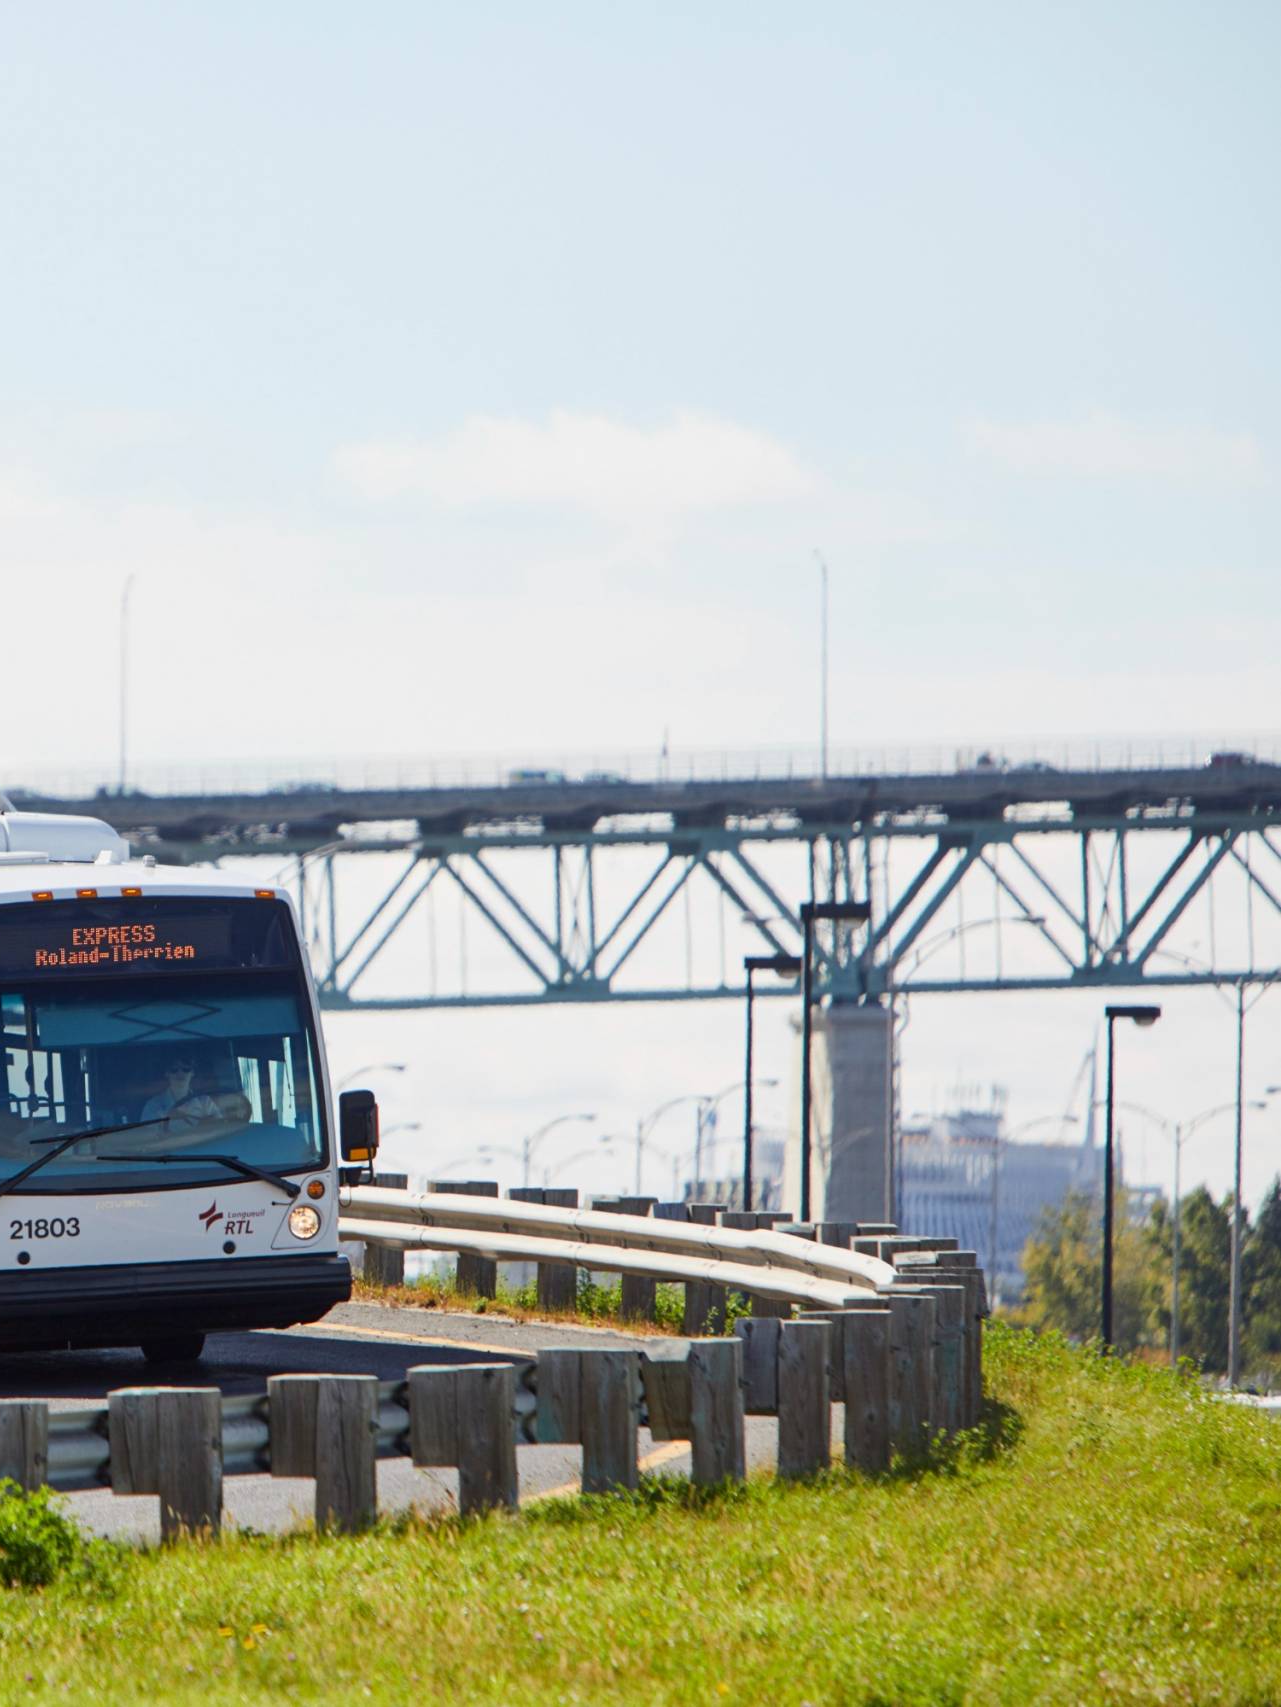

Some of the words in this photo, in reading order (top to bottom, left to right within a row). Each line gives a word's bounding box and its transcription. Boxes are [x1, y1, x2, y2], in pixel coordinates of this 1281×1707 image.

[72, 924, 156, 946] EXPRESS
[35, 942, 195, 967] Roland-Therrien
[227, 1209, 266, 1220] Longueuil
[9, 1217, 81, 1240] 21803
[224, 1220, 254, 1235] RTL
